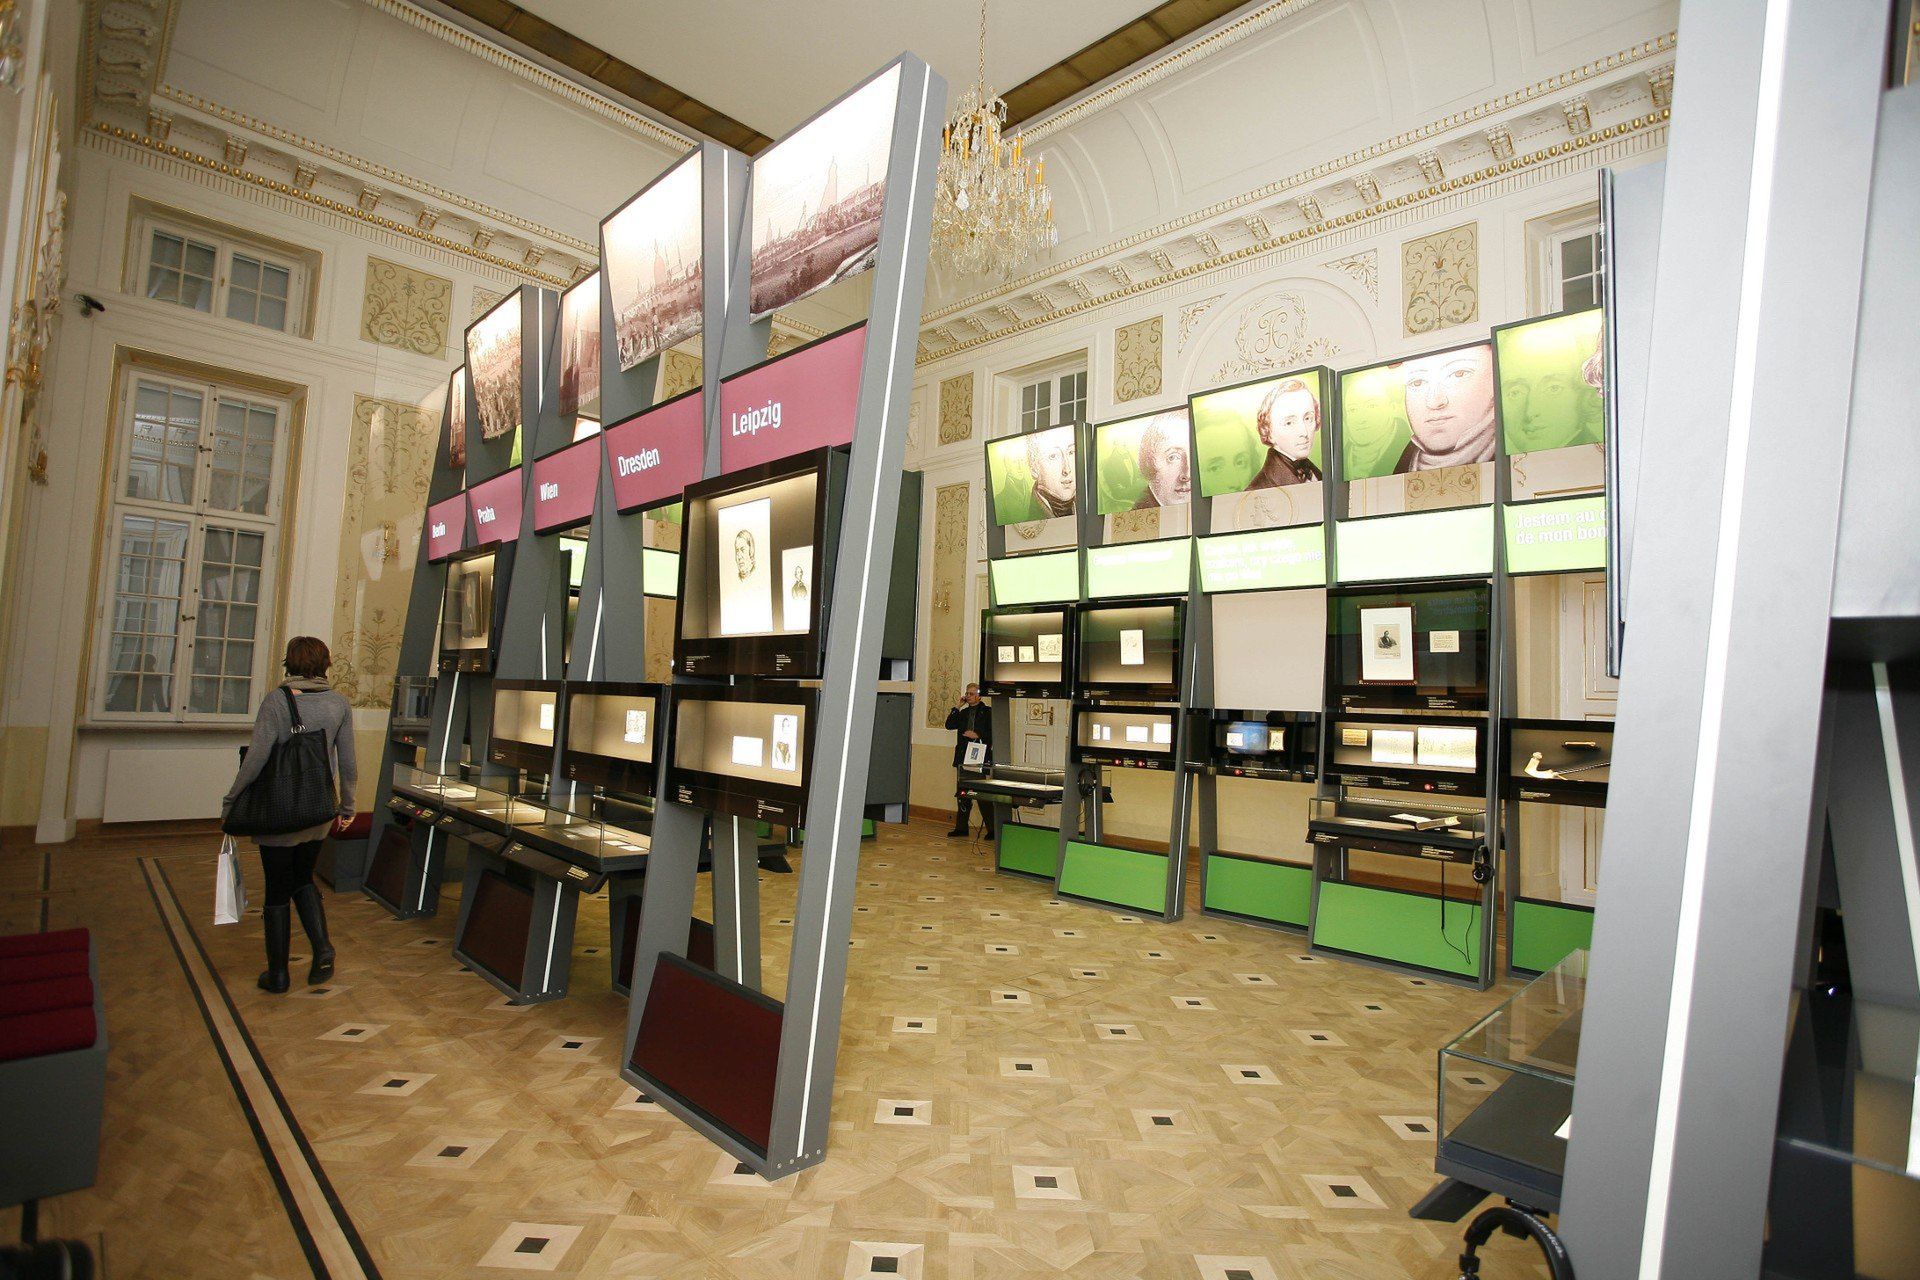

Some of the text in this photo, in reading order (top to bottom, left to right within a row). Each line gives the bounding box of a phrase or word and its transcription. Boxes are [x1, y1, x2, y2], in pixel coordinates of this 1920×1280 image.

[732, 400, 782, 437] Leipzig
[617, 448, 660, 477] Dresden
[540, 482, 558, 501] Wien
[477, 506, 496, 525] Praha
[1515, 512, 1570, 528] Jestem
[1515, 530, 1535, 545] de
